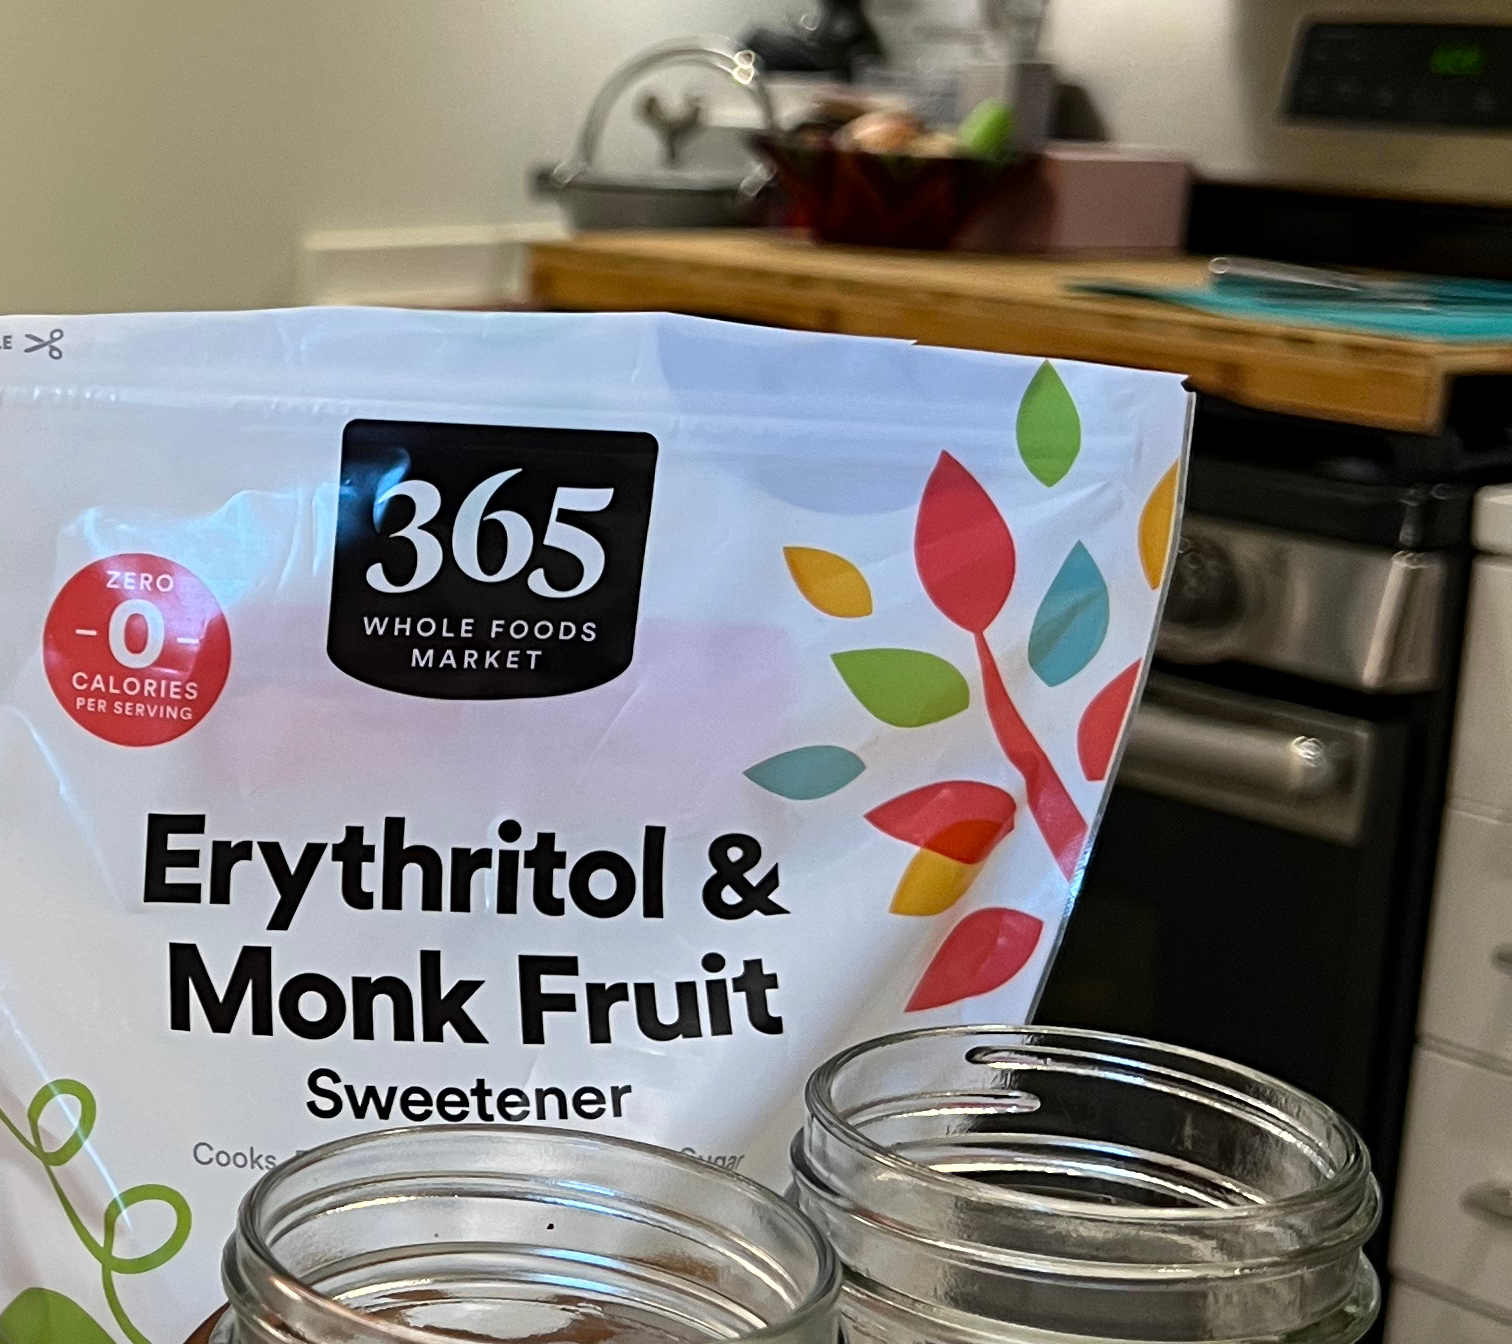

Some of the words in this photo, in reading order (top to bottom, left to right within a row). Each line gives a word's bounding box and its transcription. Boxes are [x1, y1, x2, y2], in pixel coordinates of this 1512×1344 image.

[365, 467, 615, 599] 365
[106, 570, 174, 593] ZERO
[363, 616, 474, 638] WHOLE
[490, 620, 597, 642] FOODS
[410, 649, 542, 670] MARKET
[72, 672, 198, 700] CALORIES
[76, 697, 107, 713] PER
[113, 701, 193, 720] SERVING
[142, 813, 666, 931] Erythritol
[701, 832, 791, 919] &
[168, 940, 489, 1045] Monk
[517, 952, 786, 1047] Fruit
[306, 1067, 632, 1123] Sweetener
